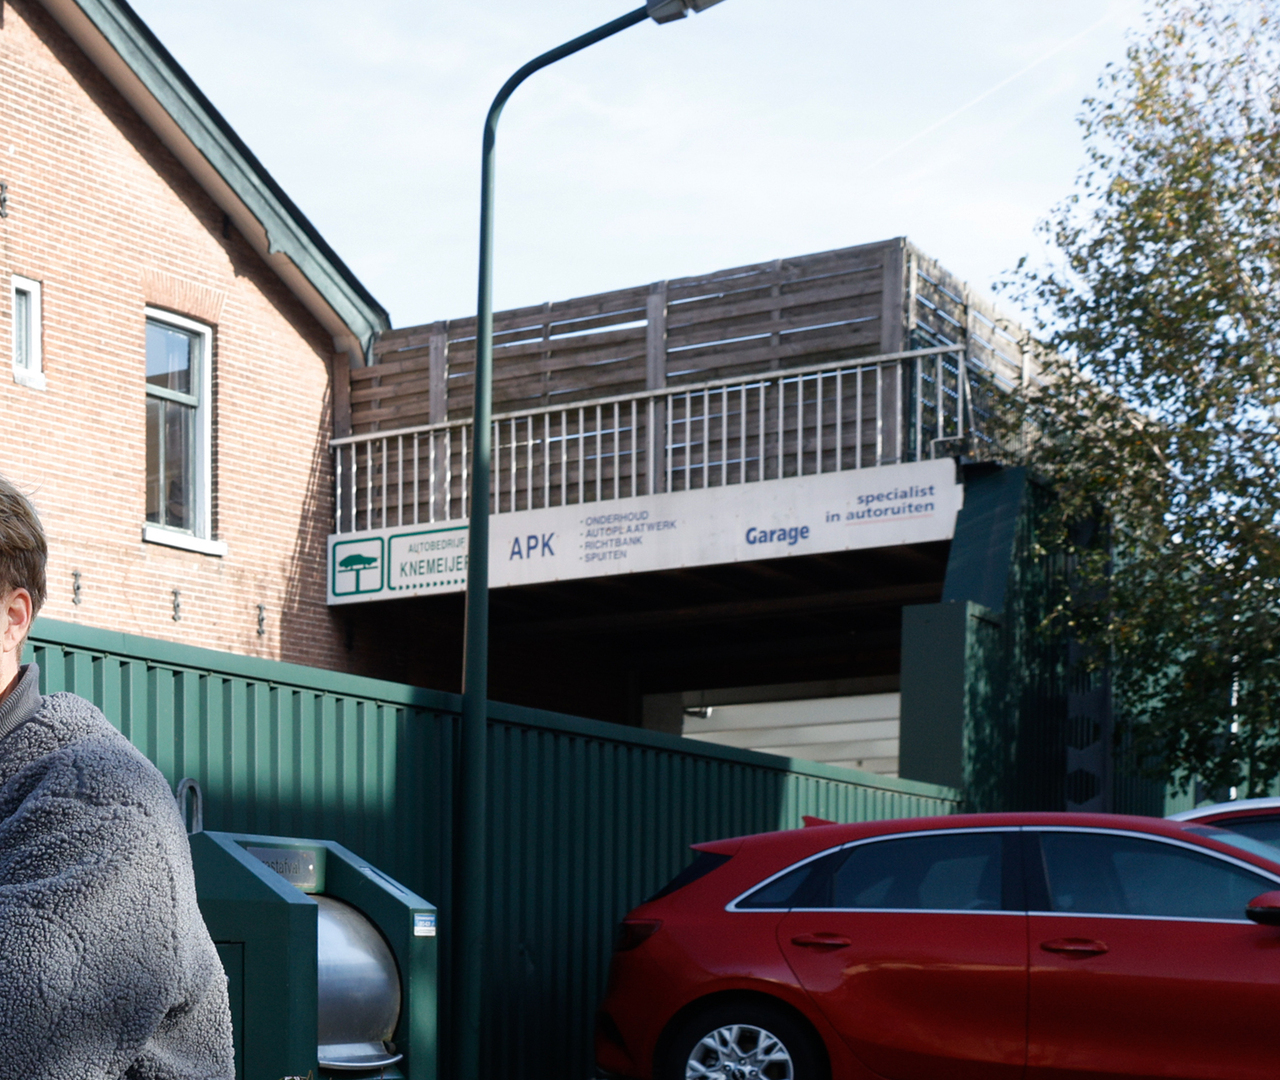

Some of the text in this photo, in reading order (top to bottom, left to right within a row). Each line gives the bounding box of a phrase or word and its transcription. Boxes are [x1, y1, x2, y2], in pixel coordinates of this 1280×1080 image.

[856, 485, 936, 506] specialist
[585, 510, 649, 527] ONDERHOUD
[825, 500, 936, 523] in autoruiten
[585, 520, 677, 538] AUTOPLAATWERK
[745, 525, 810, 546] Garage
[407, 537, 466, 553] AUTOBEDRIJF
[509, 532, 556, 561] APK
[584, 536, 643, 550] RICHTBANK
[584, 550, 628, 563] SPUITEN
